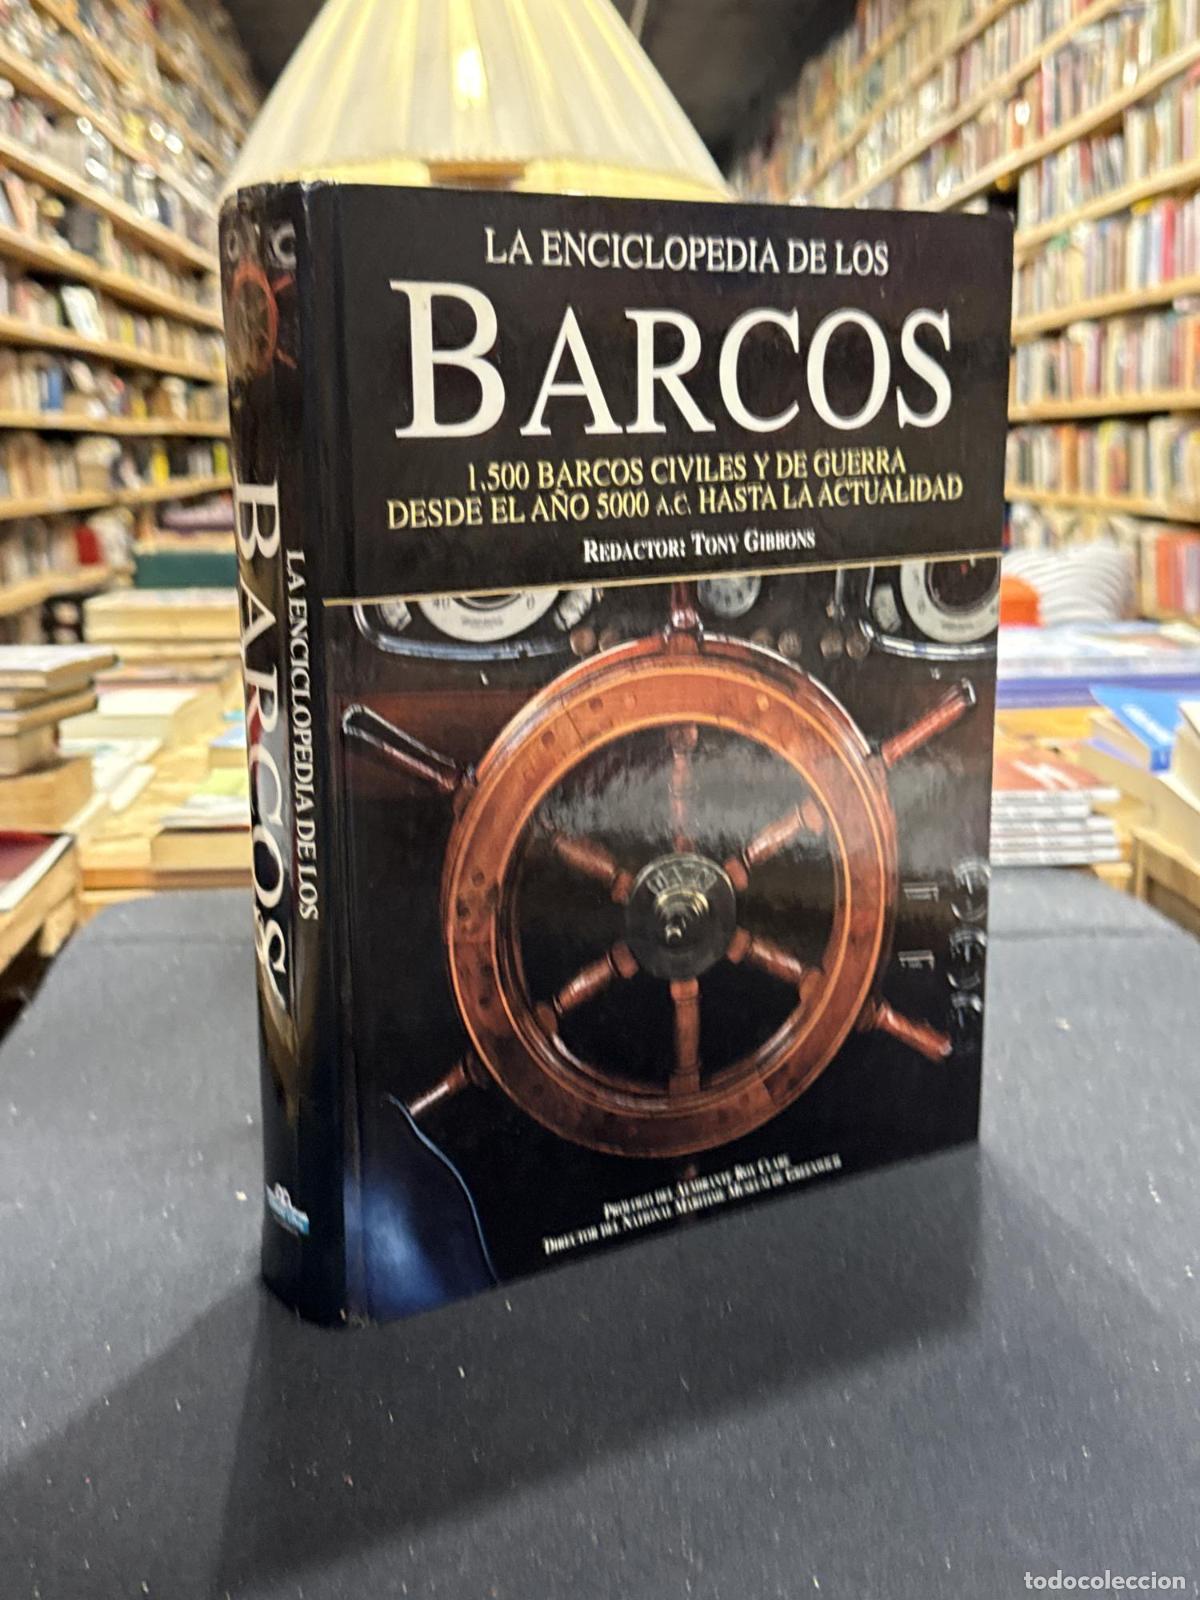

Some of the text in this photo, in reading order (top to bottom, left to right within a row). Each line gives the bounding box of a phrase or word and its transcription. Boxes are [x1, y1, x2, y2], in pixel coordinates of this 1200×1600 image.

[483, 225, 889, 277] LA ENCICLOPEDIA DE LOS
[389, 279, 954, 440] BARCOS
[467, 446, 907, 493] 1.500 BARCOS CIVILES Y DE GUERRA
[387, 496, 484, 530] DESDE
[491, 495, 526, 525] EL
[531, 486, 590, 523] AÑO
[596, 488, 650, 521] 5000
[699, 479, 778, 515] HASTA
[783, 481, 814, 510] LA
[818, 472, 964, 508] ACTUALIDAD
[691, 529, 740, 558] TONY
[743, 526, 817, 554] GIBBONS
[235, 479, 287, 1011] BARCOS
[286, 550, 319, 921] LA ENCICLOPEDIA DE LOS
